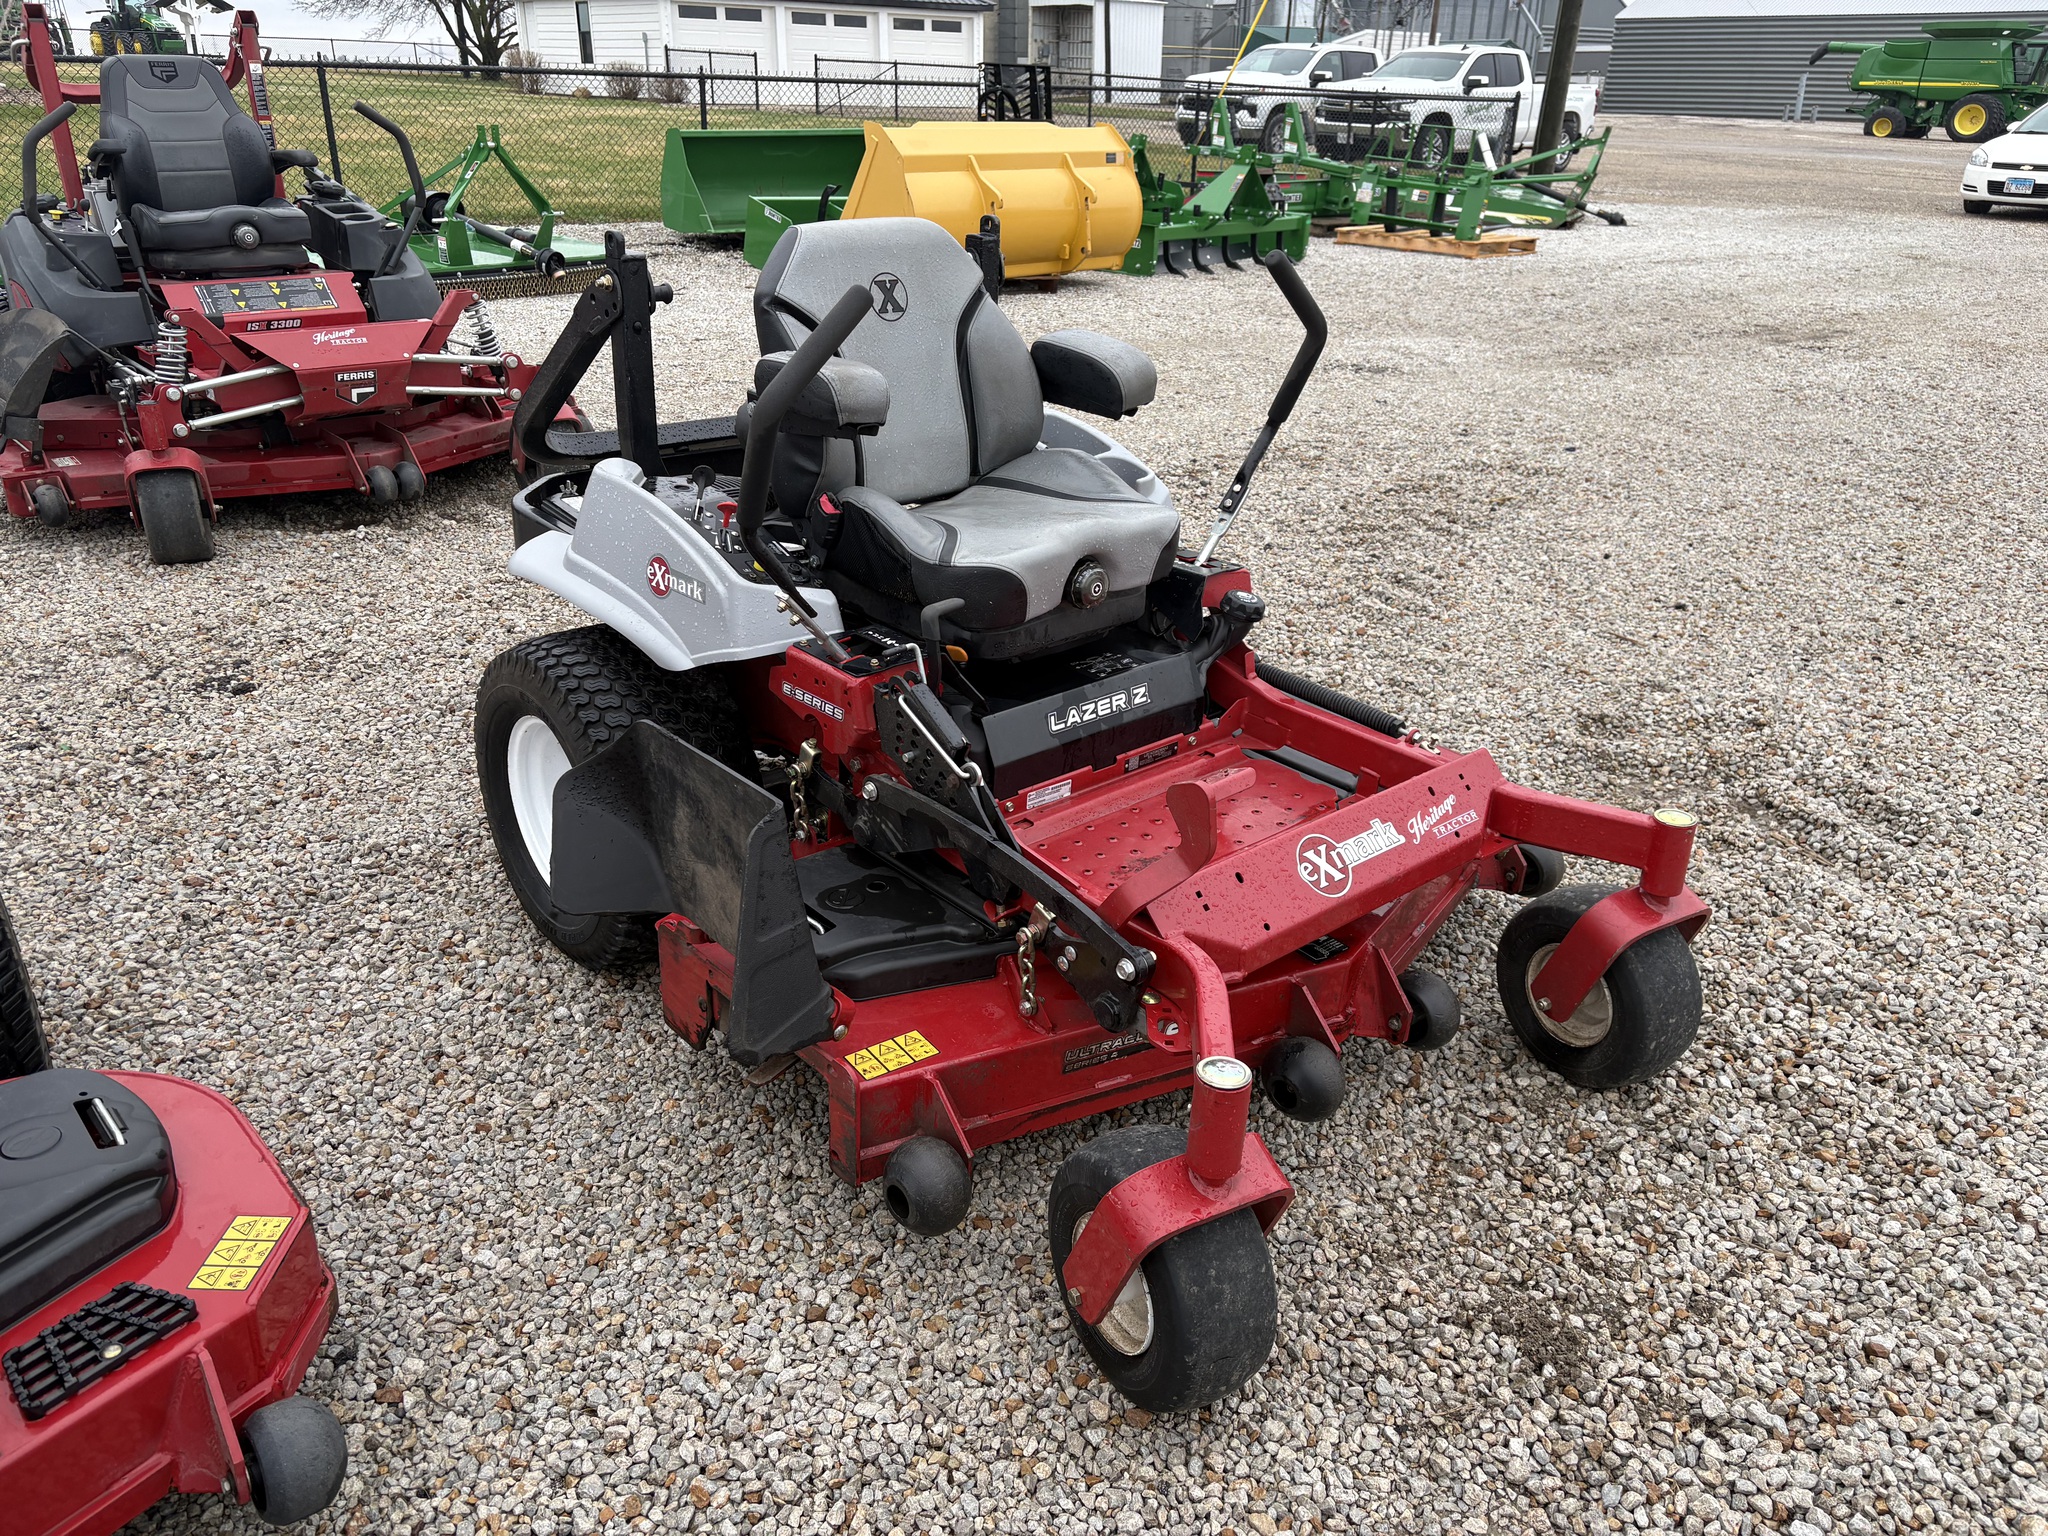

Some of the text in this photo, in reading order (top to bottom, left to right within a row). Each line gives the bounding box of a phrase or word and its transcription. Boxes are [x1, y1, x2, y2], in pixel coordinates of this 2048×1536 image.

[270, 319, 302, 329] 3300
[312, 328, 356, 345] Heritage
[330, 337, 368, 345] TRACTOR
[337, 371, 375, 381] FERRIS
[1048, 683, 1151, 734] LAZER Z
[1408, 794, 1457, 844] Heritage
[1433, 810, 1479, 838] TRACTOR
